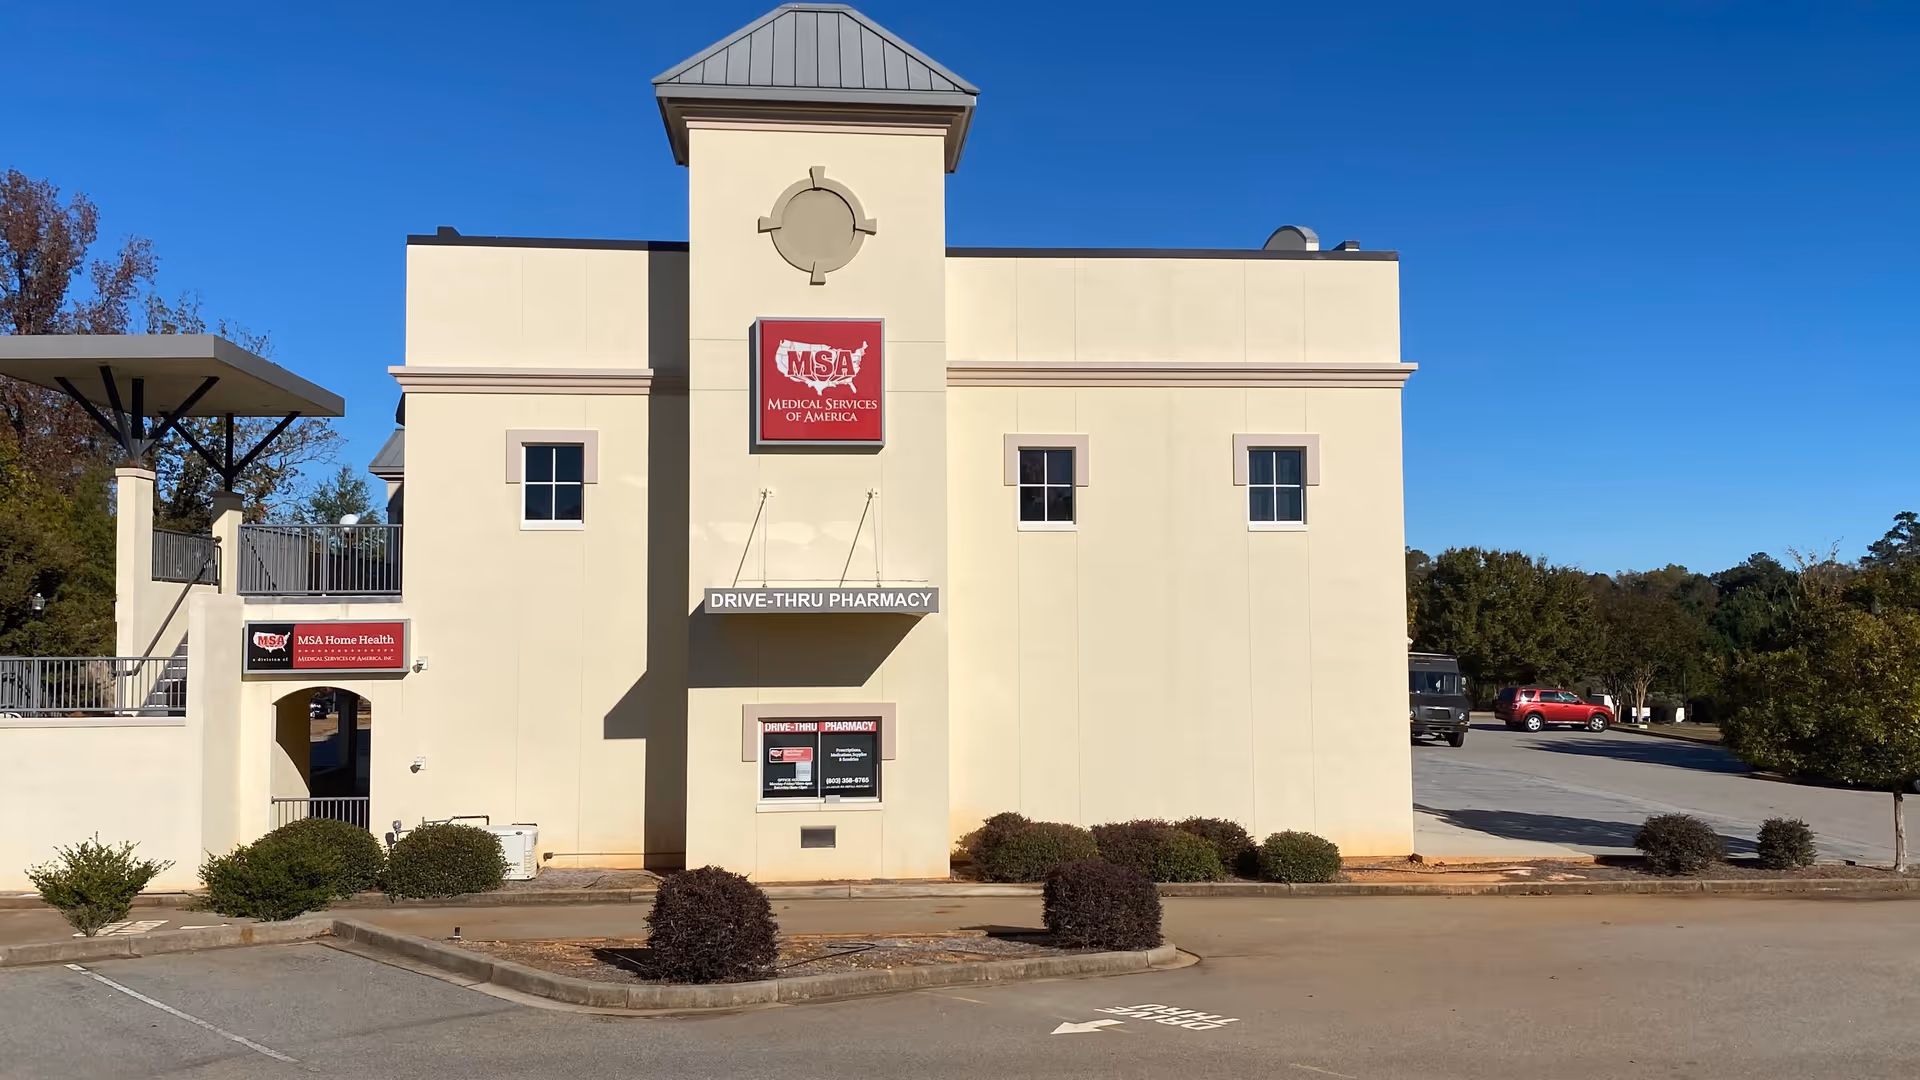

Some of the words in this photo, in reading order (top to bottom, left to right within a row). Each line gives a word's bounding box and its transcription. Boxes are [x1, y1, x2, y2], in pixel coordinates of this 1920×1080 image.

[787, 350, 857, 378] MSA
[767, 398, 822, 411] MEDICAL
[825, 398, 878, 411] SERVICES
[786, 412, 801, 422] OF
[803, 411, 858, 423] AMERICA
[710, 593, 824, 608] DRIVE-THRU
[829, 592, 933, 608] PHARMACY
[257, 635, 285, 647] MSA
[297, 635, 323, 645] MSA
[325, 635, 357, 645] Home
[359, 634, 395, 645] Health
[764, 722, 818, 732] DRIVE-THRU
[824, 721, 874, 731] PHARMACY
[1094, 1007, 1223, 1030] DRIVE
[1129, 1004, 1240, 1025] THRU
